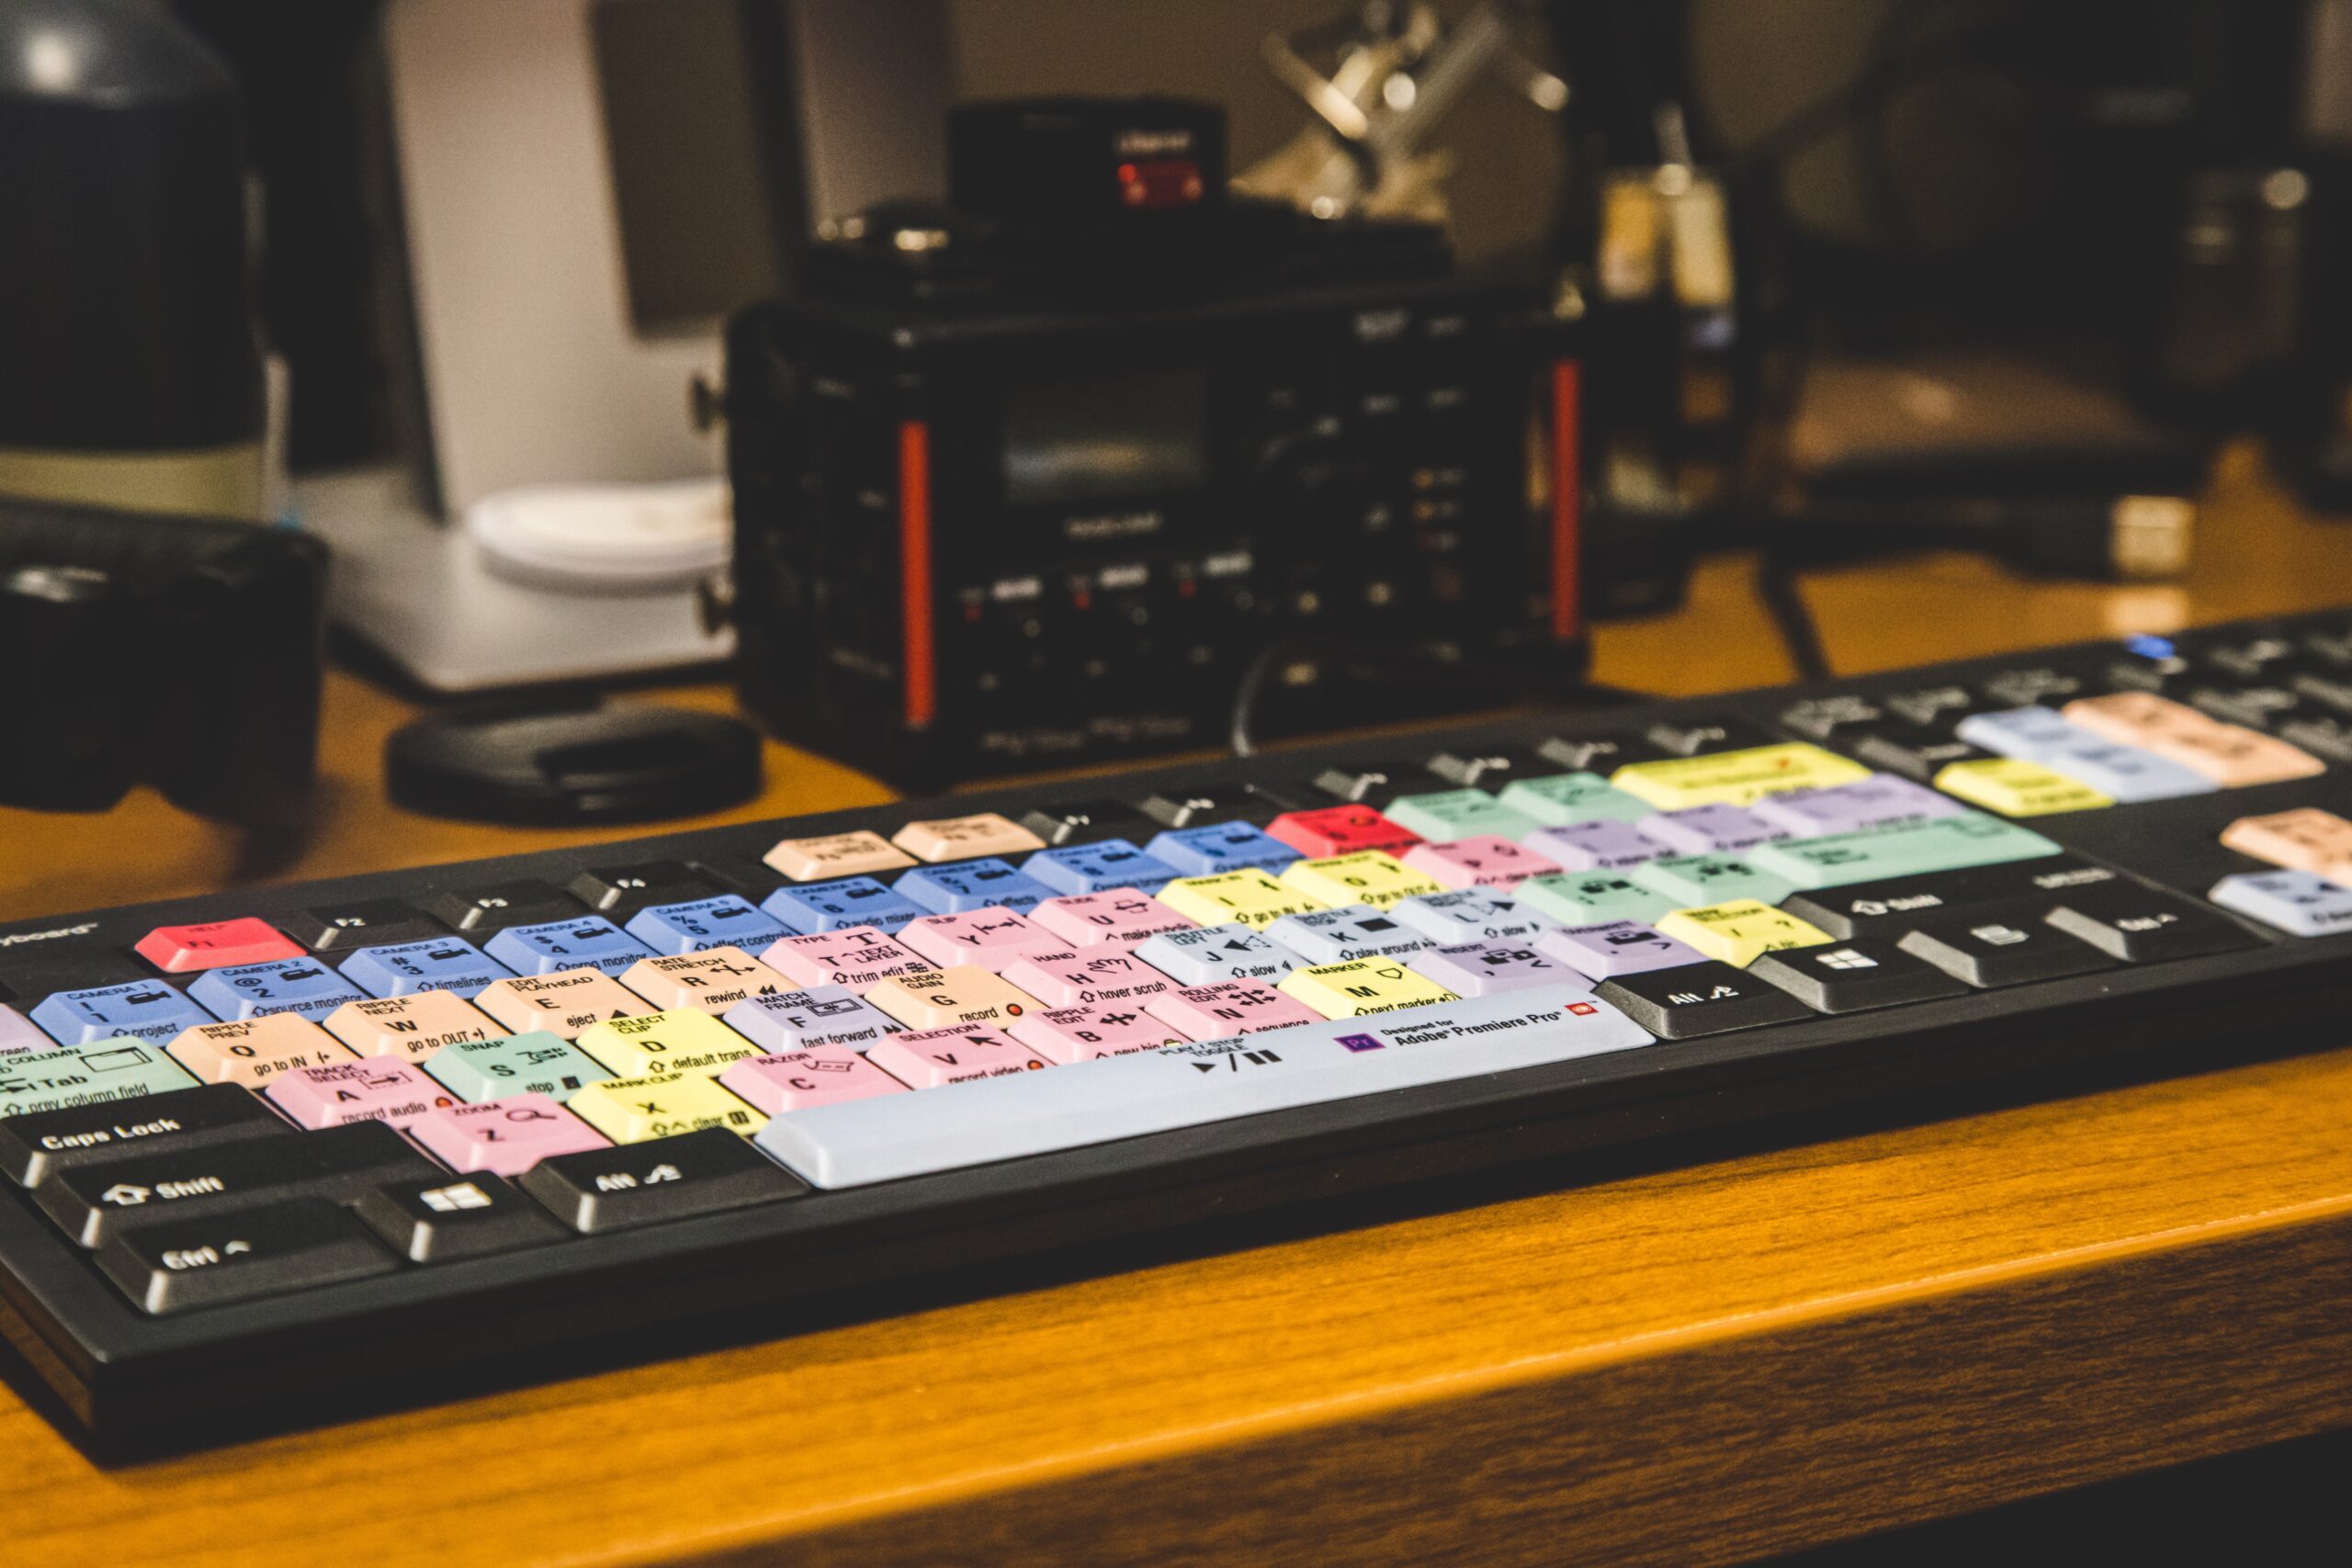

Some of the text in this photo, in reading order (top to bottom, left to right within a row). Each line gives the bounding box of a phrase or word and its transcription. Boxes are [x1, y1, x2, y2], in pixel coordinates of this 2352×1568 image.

[654, 900, 717, 915] CAMERA
[670, 916, 699, 927] %
[852, 911, 917, 931] audio mixer
[1089, 915, 1115, 926] U
[1453, 912, 1479, 923] L
[515, 919, 593, 935] CAMERA 4
[690, 924, 710, 935] 5
[1164, 926, 1228, 942] SHUTTLE
[534, 934, 553, 945] $
[790, 935, 832, 946] TYPE
[956, 934, 982, 946] Y
[1121, 930, 1153, 942] make
[1172, 935, 1208, 946] LEFT
[1329, 931, 1358, 942] K
[370, 940, 449, 955] CAMERA 3
[550, 944, 571, 955] 4
[711, 937, 746, 950] effect
[854, 944, 899, 957] TEXT
[1355, 941, 1420, 960] play around
[1438, 943, 1487, 955] INSERT
[390, 955, 410, 966] #
[602, 952, 648, 968] monitor
[650, 956, 686, 967] RATE
[819, 955, 842, 967] T
[854, 950, 905, 964] LAYER
[1033, 952, 1078, 964] HAND
[1205, 951, 1224, 963] J
[221, 963, 284, 976] CAMERA
[401, 965, 424, 976] 3
[659, 957, 728, 973] STRETCH
[1250, 964, 1277, 979] slow
[1308, 962, 1369, 976] MARKER
[233, 976, 263, 988] @
[435, 974, 492, 991] timelines
[506, 977, 540, 987] EDIT
[681, 976, 709, 988] R
[851, 965, 906, 987] trim edit
[898, 972, 945, 986] AUDIO
[1066, 973, 1095, 986] H
[514, 976, 594, 993] PLAYHEAD
[906, 979, 946, 991] GAIN
[1096, 979, 1168, 1002] hover scrub
[1177, 983, 1239, 997] ROLLING
[67, 986, 135, 1001] CAMERA
[251, 987, 277, 999] 2
[704, 988, 748, 1006] rewind
[755, 990, 810, 1006] MATCH
[1187, 992, 1221, 1004] EDIT
[1345, 986, 1380, 998] M
[1667, 992, 1705, 1006] Alt
[79, 1001, 95, 1012] !
[269, 993, 364, 1015] source monitor
[356, 998, 412, 1010] RIPPLE
[535, 997, 562, 1010] E
[764, 998, 819, 1012] FRAME
[930, 995, 959, 1008] G
[1369, 997, 1437, 1016] next marker
[90, 1012, 111, 1023] 1
[363, 1005, 407, 1016] NEXT
[958, 1007, 1001, 1024] record
[1042, 1005, 1096, 1020] RIPPLE
[1212, 1008, 1246, 1021] N
[383, 1020, 418, 1032] W
[566, 1012, 598, 1030] eject
[608, 1013, 667, 1030] SELECT
[787, 1015, 808, 1029] F
[1052, 1013, 1089, 1026] EDIT
[1453, 1013, 1529, 1038] Premiere
[131, 1021, 180, 1039] project
[199, 1021, 257, 1035] RIPPLE
[617, 1024, 652, 1036] CLIP
[899, 1022, 983, 1043] SELECTION
[1380, 1019, 1455, 1037] Designed for
[208, 1030, 251, 1041] PREV
[407, 1030, 469, 1054] go to OUT
[800, 1025, 879, 1051] fast forward
[1074, 1030, 1103, 1043] B
[459, 1040, 504, 1053] SNAP
[639, 1040, 668, 1053] D
[1158, 1037, 1246, 1056] PLAY STOP
[1347, 1037, 1372, 1049] Pr
[7, 1047, 83, 1066] COLUMN
[230, 1044, 257, 1058] Q
[1193, 1043, 1251, 1058] TOGGLE
[254, 1055, 308, 1077] go to IN
[672, 1048, 753, 1071] default trans
[756, 1053, 813, 1066] RAZOR
[932, 1053, 959, 1066] V
[301, 1063, 357, 1077] TRACK
[309, 1068, 371, 1084] SELECT
[489, 1064, 517, 1077] S
[38, 1074, 89, 1089] Tab
[525, 1081, 556, 1096] stop
[602, 1072, 684, 1092] MARK CLIP
[788, 1077, 818, 1091] C
[63, 1081, 150, 1108] column field
[335, 1089, 361, 1102] A
[341, 1102, 428, 1125] record audio
[452, 1102, 503, 1116] ZOOM
[637, 1101, 669, 1115] X
[691, 1114, 726, 1131] clear
[41, 1118, 182, 1150] Caps Lock
[475, 1128, 506, 1143] Z
[155, 1176, 225, 1200] Shift
